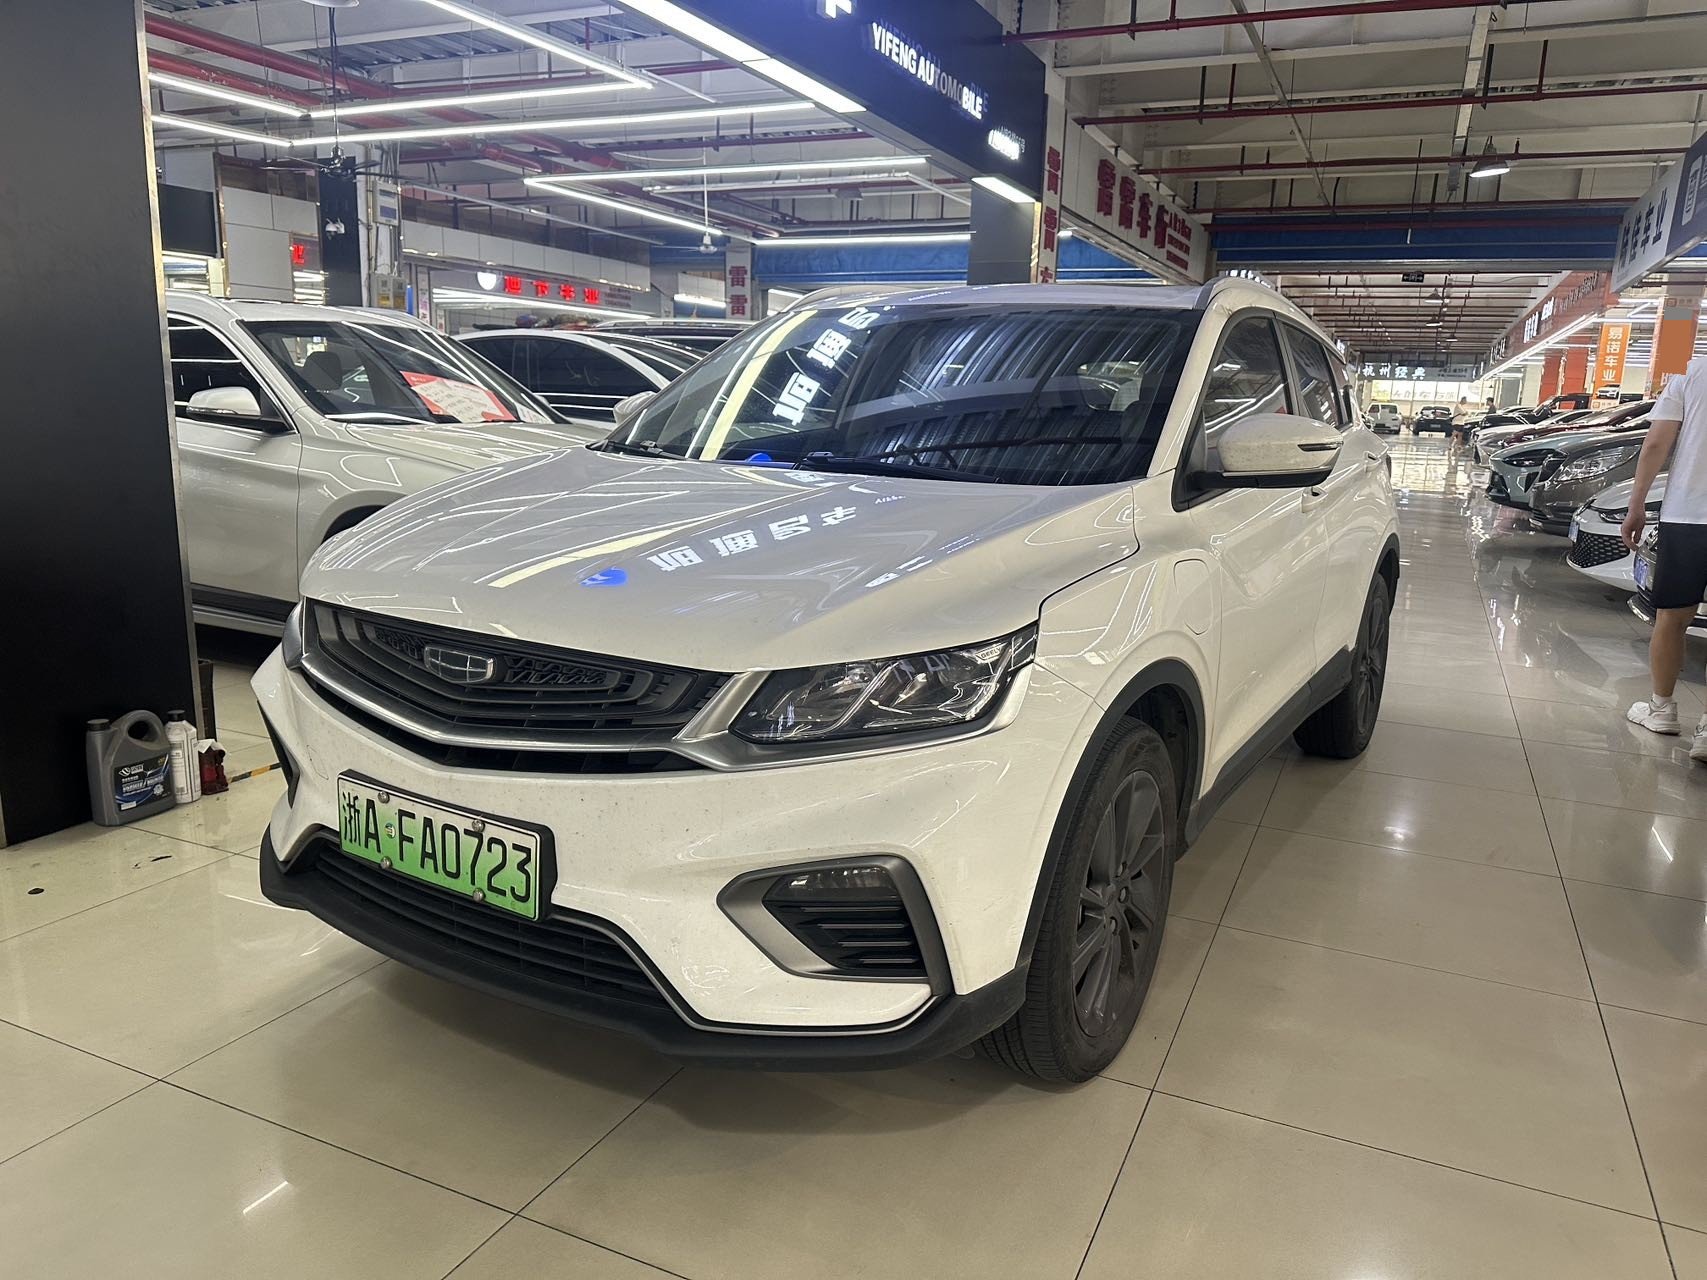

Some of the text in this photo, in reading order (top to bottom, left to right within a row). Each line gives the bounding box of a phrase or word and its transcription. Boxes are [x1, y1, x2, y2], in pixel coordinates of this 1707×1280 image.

[872, 22, 983, 120] YIFENG AUTOMOBILE
[1602, 326, 1623, 381] 易诺车业
[980, 648, 1001, 659] GEELY
